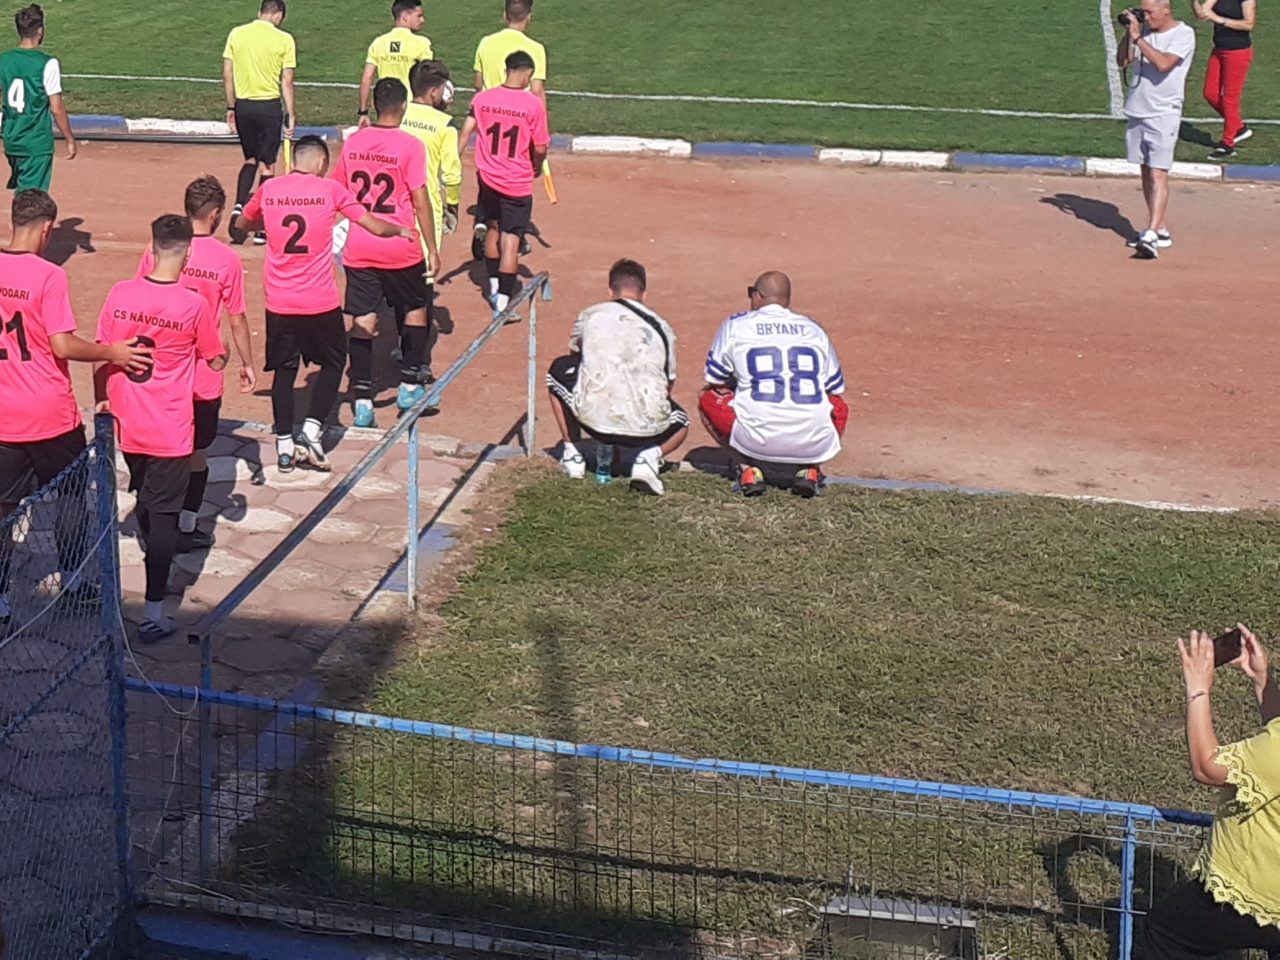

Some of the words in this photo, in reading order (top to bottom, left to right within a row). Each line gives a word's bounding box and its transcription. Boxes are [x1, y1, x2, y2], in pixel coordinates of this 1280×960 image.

[8, 78, 25, 113] 4
[486, 121, 519, 159] 11
[265, 198, 274, 206] CS
[351, 170, 396, 214] 22
[282, 214, 308, 254] 2
[114, 309, 127, 320] CS
[756, 323, 806, 336] BRYANT
[746, 346, 822, 404] 88
